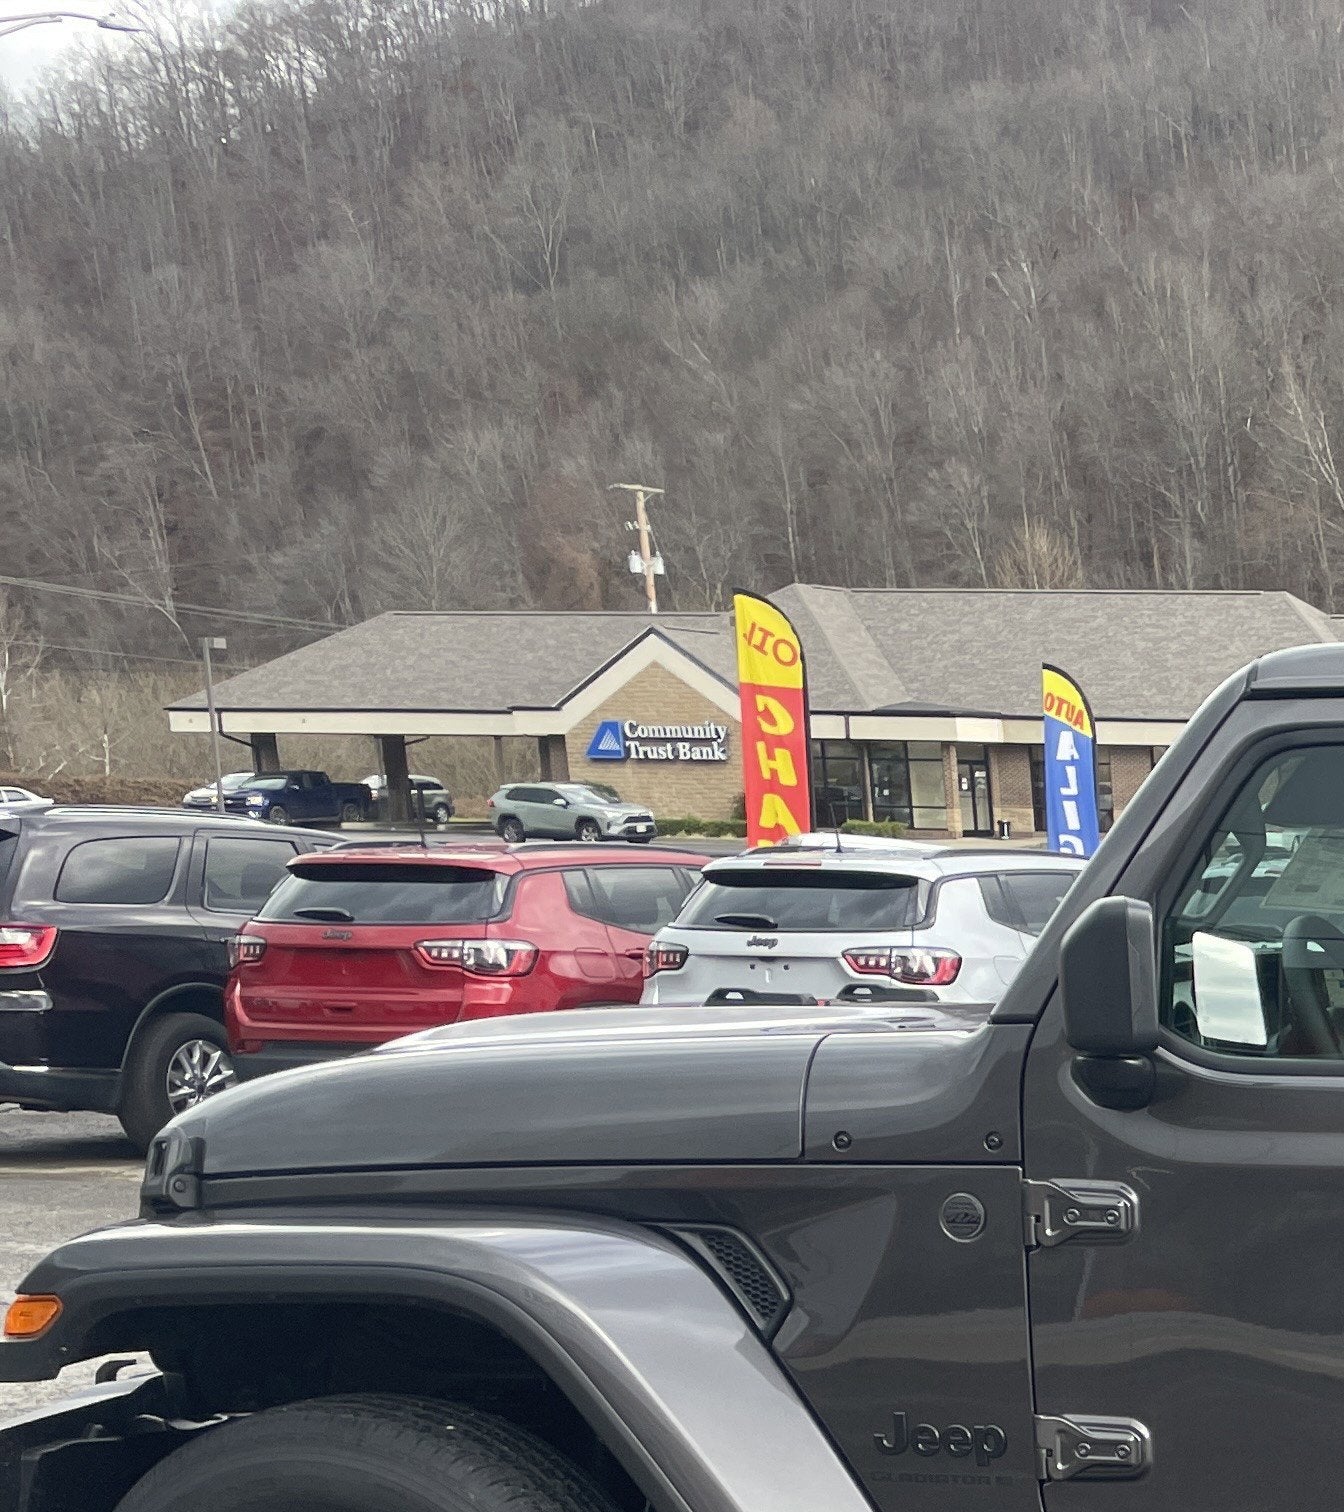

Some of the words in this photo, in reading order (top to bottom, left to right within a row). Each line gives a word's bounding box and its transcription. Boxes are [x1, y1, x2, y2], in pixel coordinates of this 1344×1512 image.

[623, 719, 727, 743] Community
[625, 740, 674, 760] Trust
[676, 741, 728, 761] Bank
[873, 1411, 1007, 1467] Jeep
